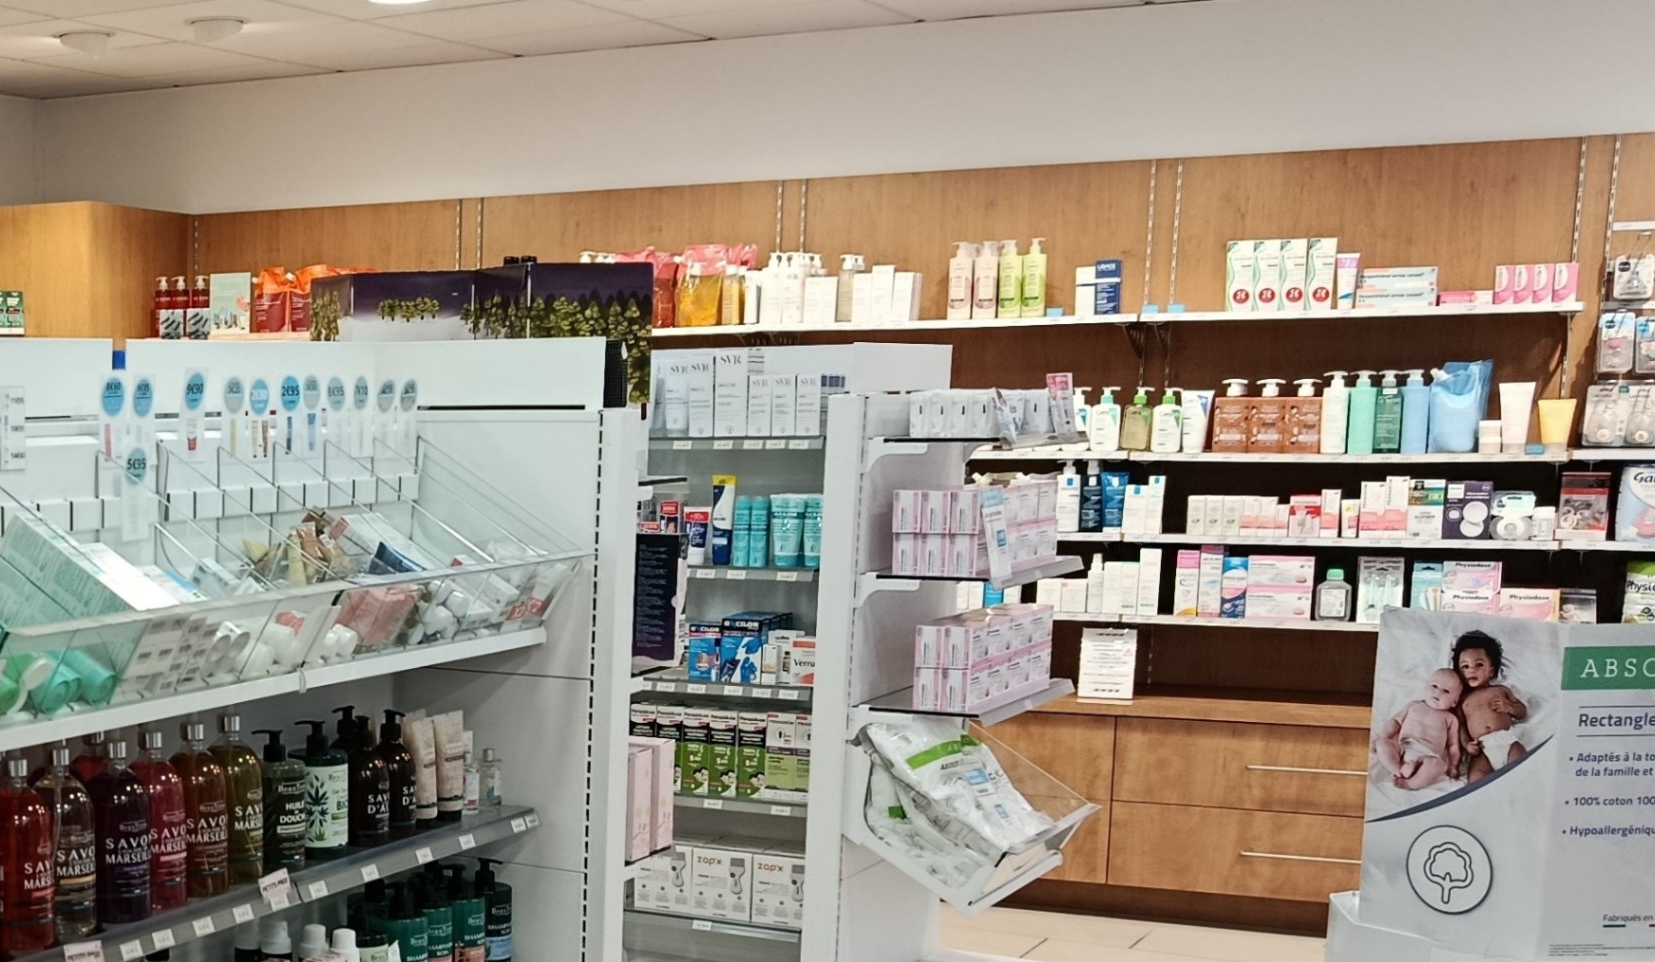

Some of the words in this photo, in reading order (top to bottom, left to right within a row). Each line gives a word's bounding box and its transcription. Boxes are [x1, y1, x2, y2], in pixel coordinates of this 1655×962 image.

[720, 355, 742, 365] SVR
[670, 365, 689, 374] SVR
[691, 363, 710, 373] SVR
[793, 658, 816, 668] Verru
[1580, 658, 1655, 679] ABSO
[1577, 752, 1621, 765] Adaptés
[1623, 752, 1630, 762] à
[1632, 752, 1642, 762] la
[1575, 767, 1587, 777] de
[1590, 767, 1599, 777] la
[1602, 766, 1637, 777] famille
[1643, 767, 1654, 776] et
[1573, 797, 1601, 806] 100%
[1603, 797, 1633, 806] coton
[1637, 796, 1655, 806] 100
[186, 814, 228, 829] SAVO
[150, 824, 187, 839] SAVO
[1569, 825, 1655, 838] Hypoallergéniqu
[105, 834, 151, 850] SAVO
[57, 845, 96, 862] SAVO
